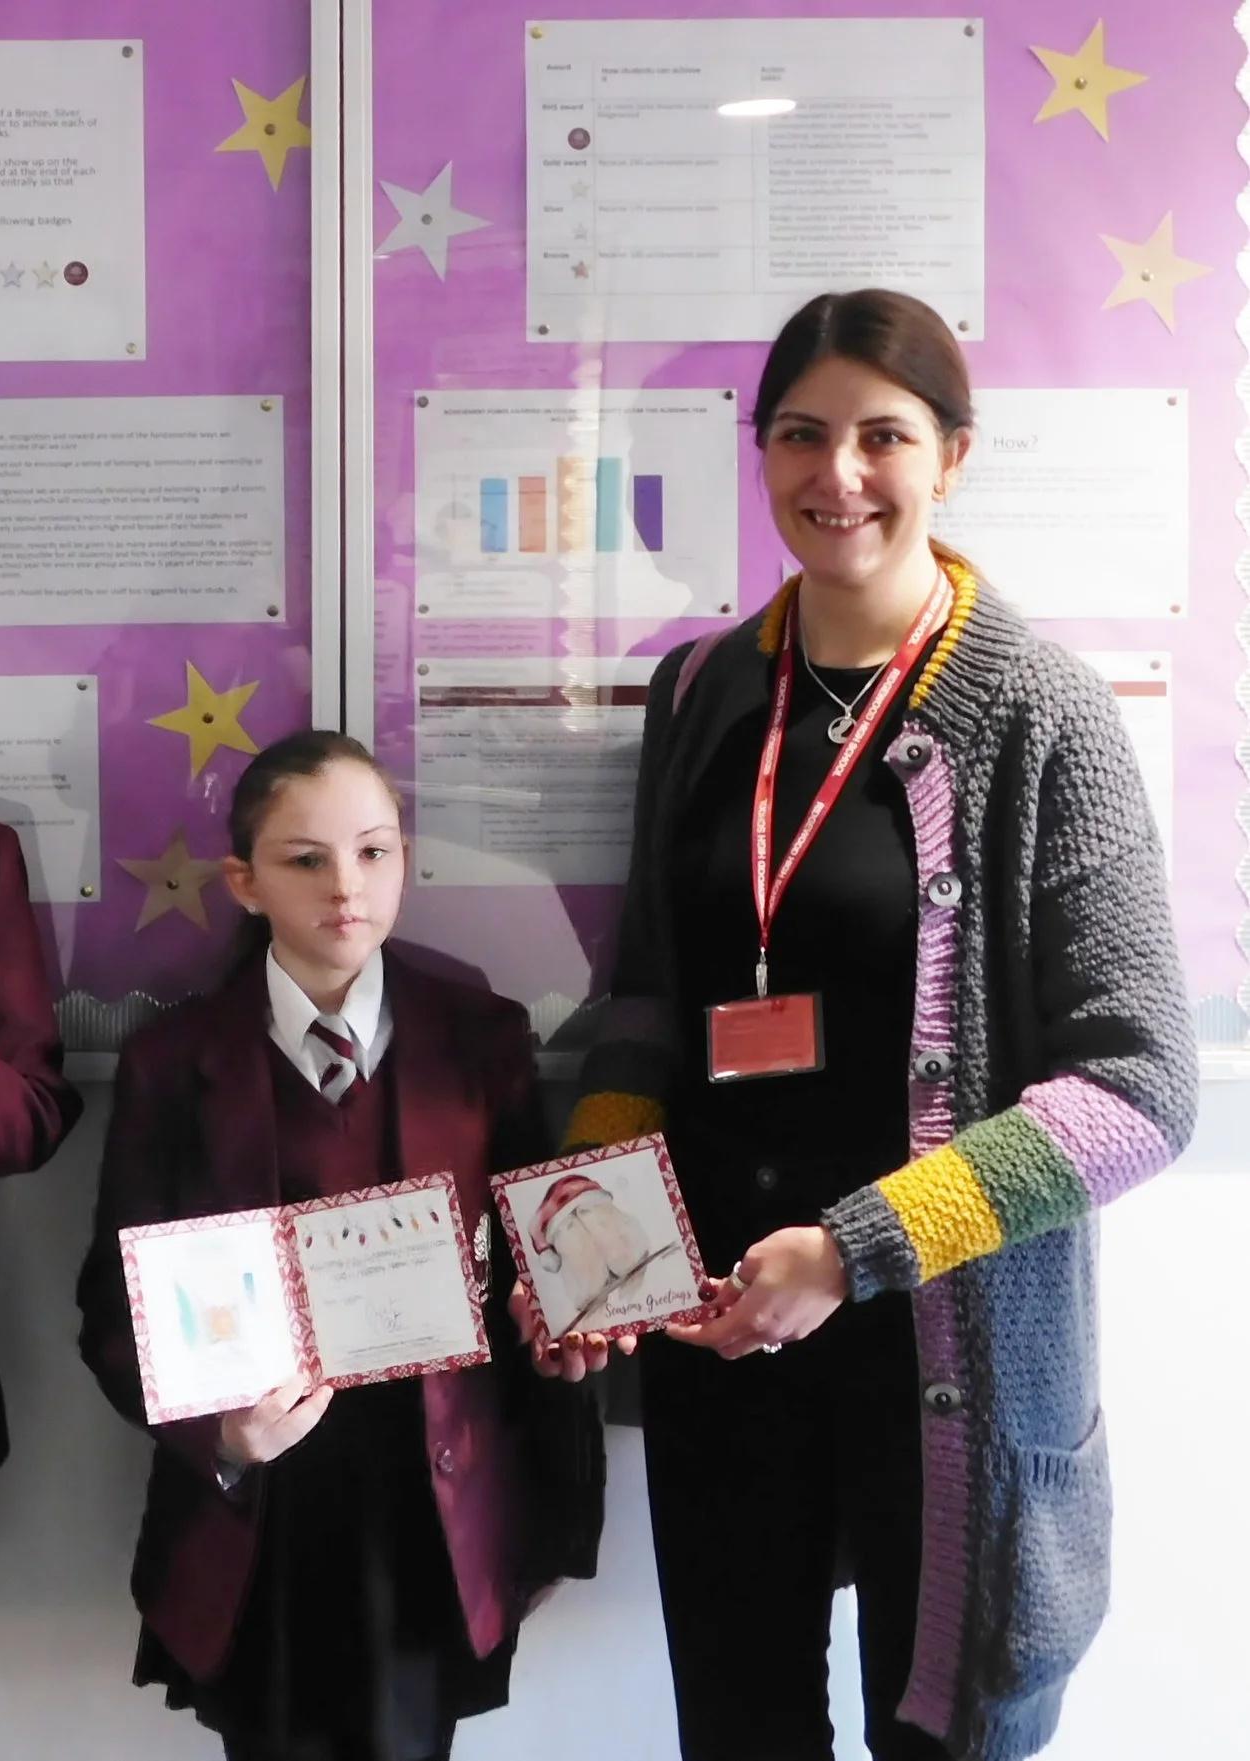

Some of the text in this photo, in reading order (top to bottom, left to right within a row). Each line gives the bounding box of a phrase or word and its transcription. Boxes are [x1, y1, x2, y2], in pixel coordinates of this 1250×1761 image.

[22, 118, 59, 128] achieve
[60, 118, 84, 127] each
[3, 158, 29, 167] show
[61, 158, 78, 167] the
[7, 168, 18, 177] at
[20, 168, 37, 177] the
[72, 167, 96, 176] each
[53, 177, 73, 186] that
[37, 216, 72, 227] badges
[993, 435, 1040, 450] How?
[776, 674, 789, 708] SCHOOL
[832, 667, 902, 777] RIDGEWOOD HIGH SCHOOL
[757, 797, 768, 834] SCHOOL
[790, 800, 825, 856] RIDGEWOOD
[756, 833, 767, 859] HIGH
[778, 855, 795, 879] HIGH
[605, 1302, 642, 1318] Seasons
